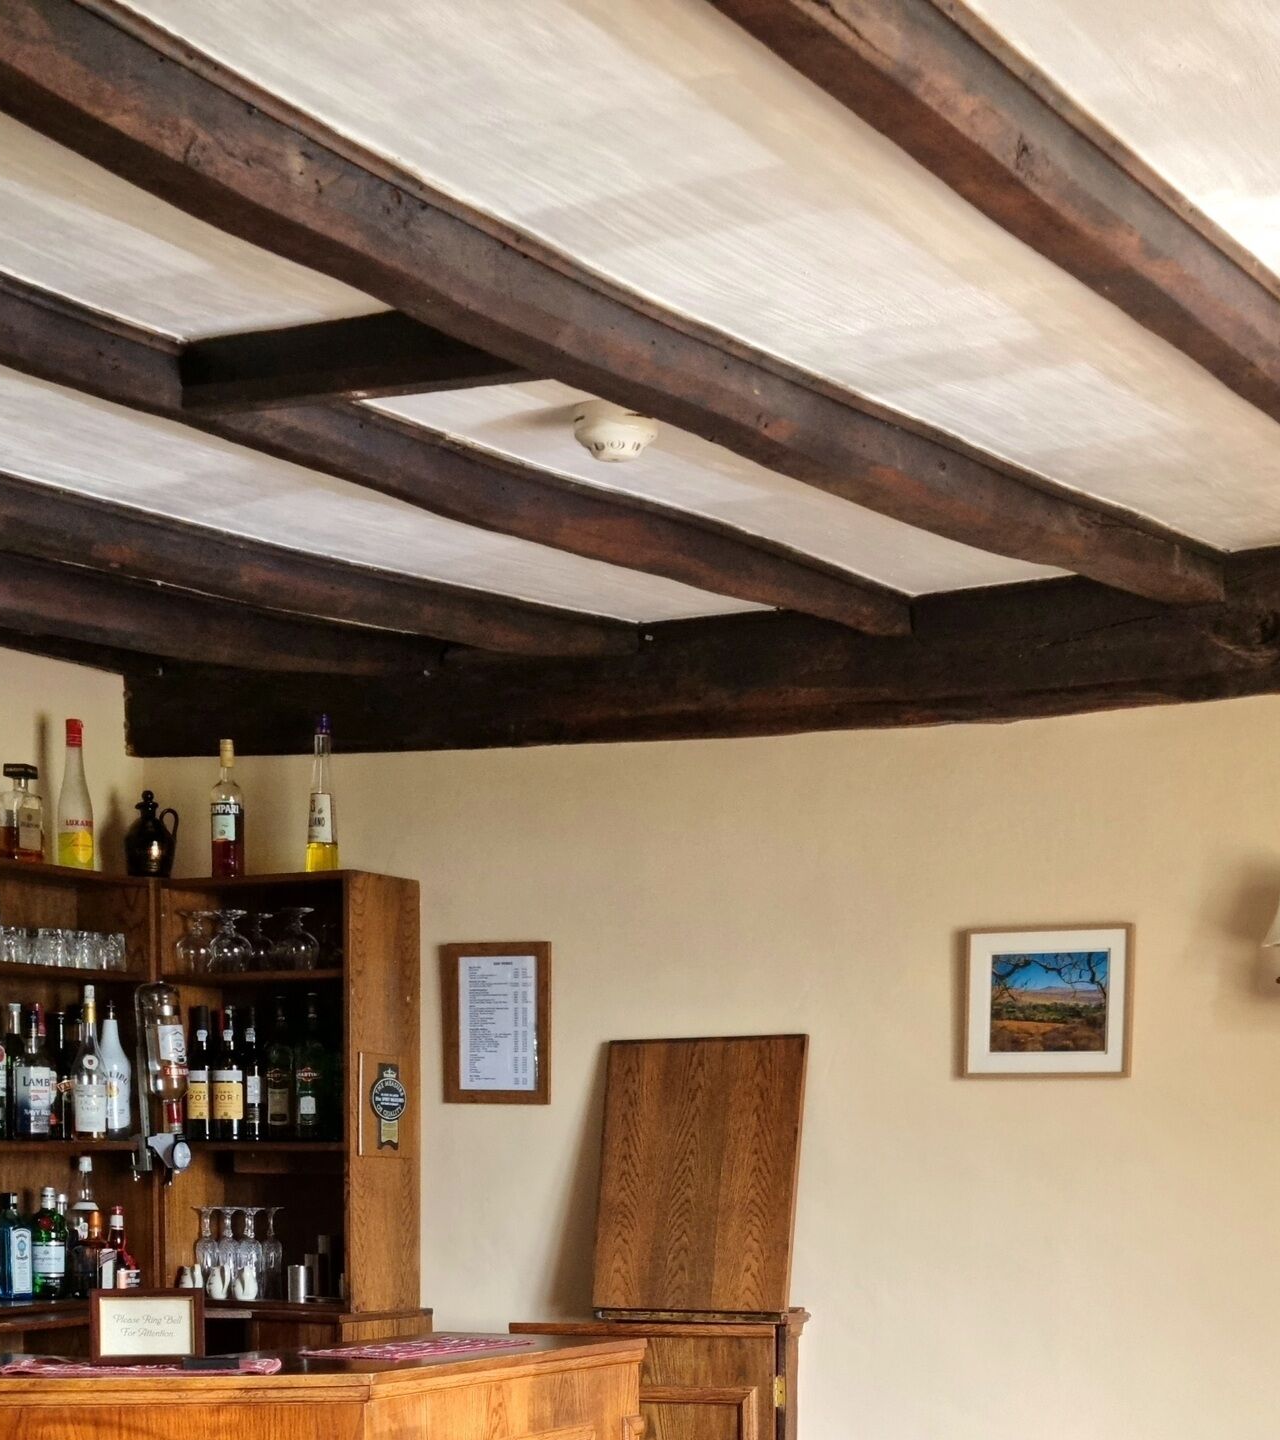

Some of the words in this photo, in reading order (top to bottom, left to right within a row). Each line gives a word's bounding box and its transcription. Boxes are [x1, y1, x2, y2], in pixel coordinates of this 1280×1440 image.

[212, 803, 239, 813] AMPARI
[113, 1313, 140, 1324] Please
[142, 1313, 163, 1326] Ring
[163, 1314, 183, 1325] Bell
[120, 1327, 136, 1337] For
[137, 1327, 175, 1338] Attention
